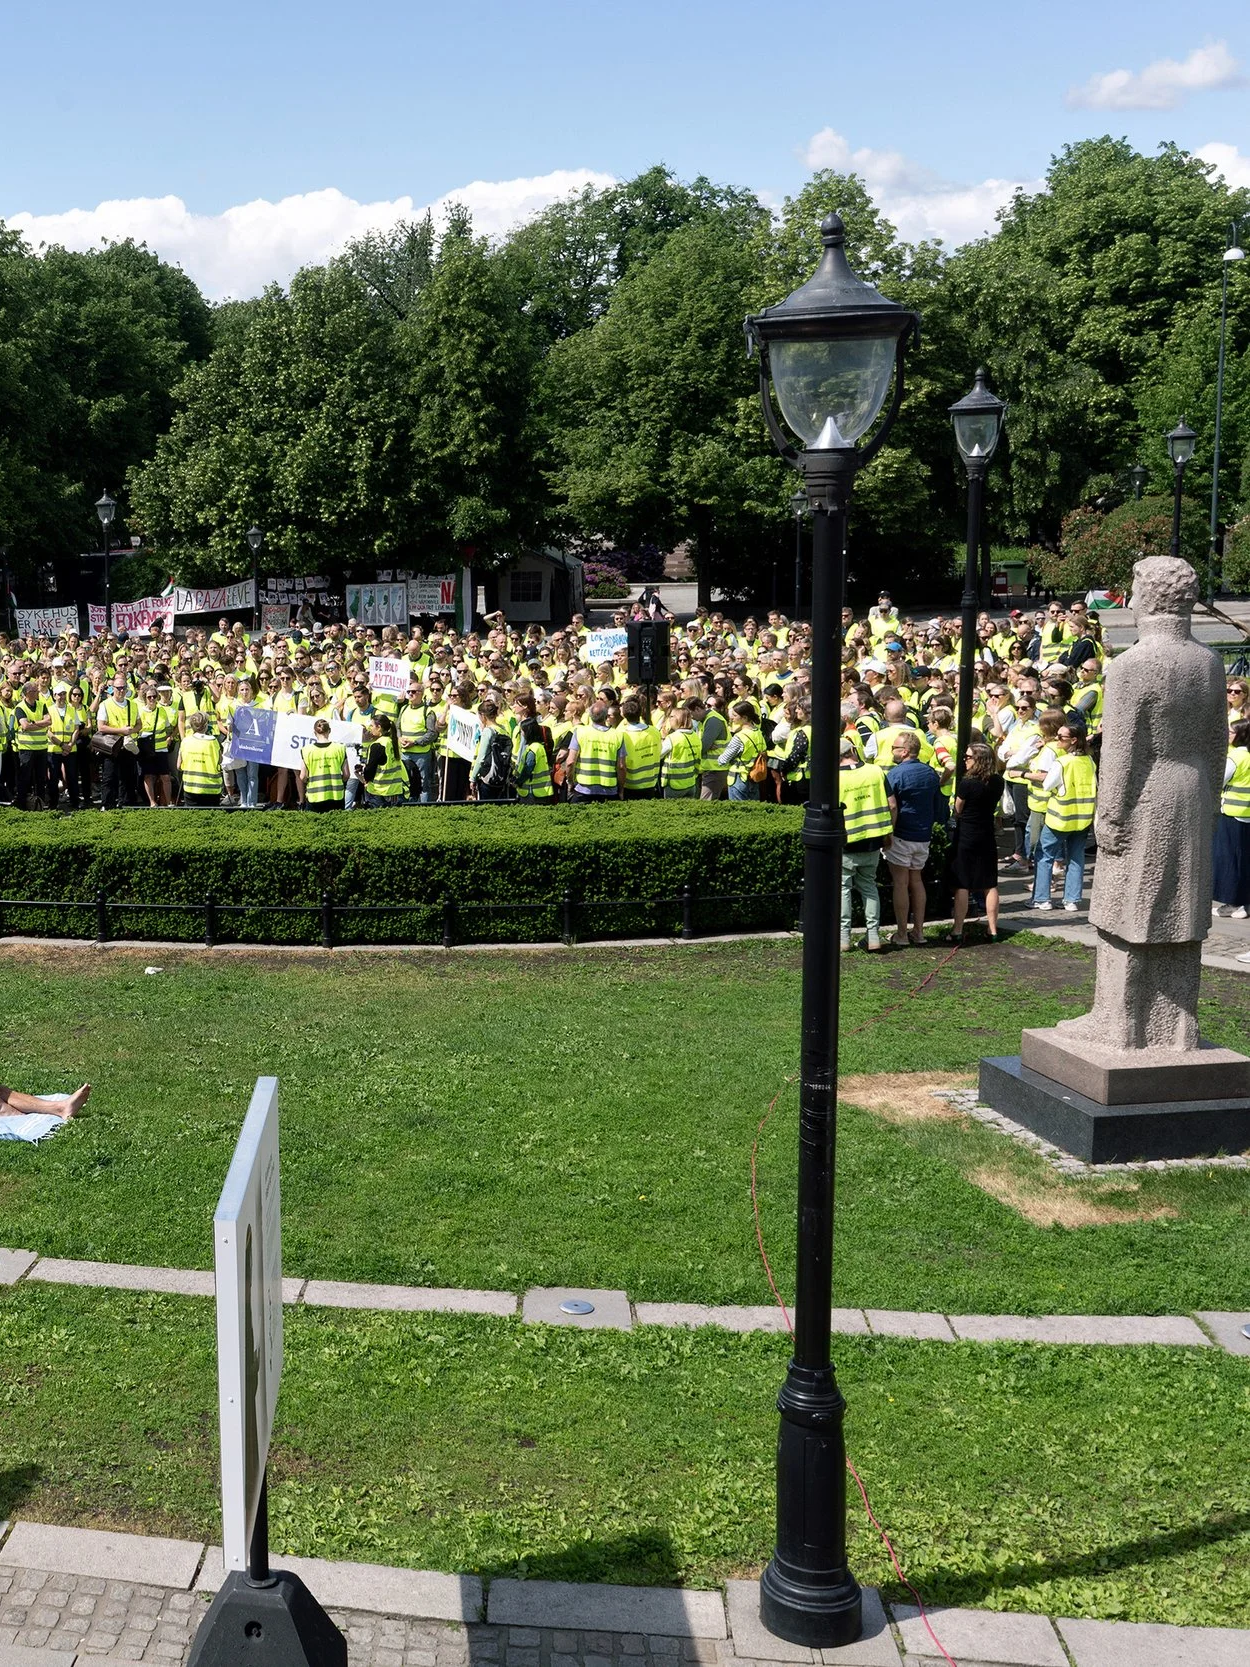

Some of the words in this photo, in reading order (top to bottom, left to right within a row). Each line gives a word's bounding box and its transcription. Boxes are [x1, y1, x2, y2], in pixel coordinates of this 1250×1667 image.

[115, 603, 135, 613] LYTT
[137, 600, 150, 610] TIL
[176, 590, 193, 611] LA
[17, 606, 78, 619] SYKEHUS
[17, 620, 30, 629] ER
[37, 618, 62, 629] IKKE
[245, 718, 261, 737] A
